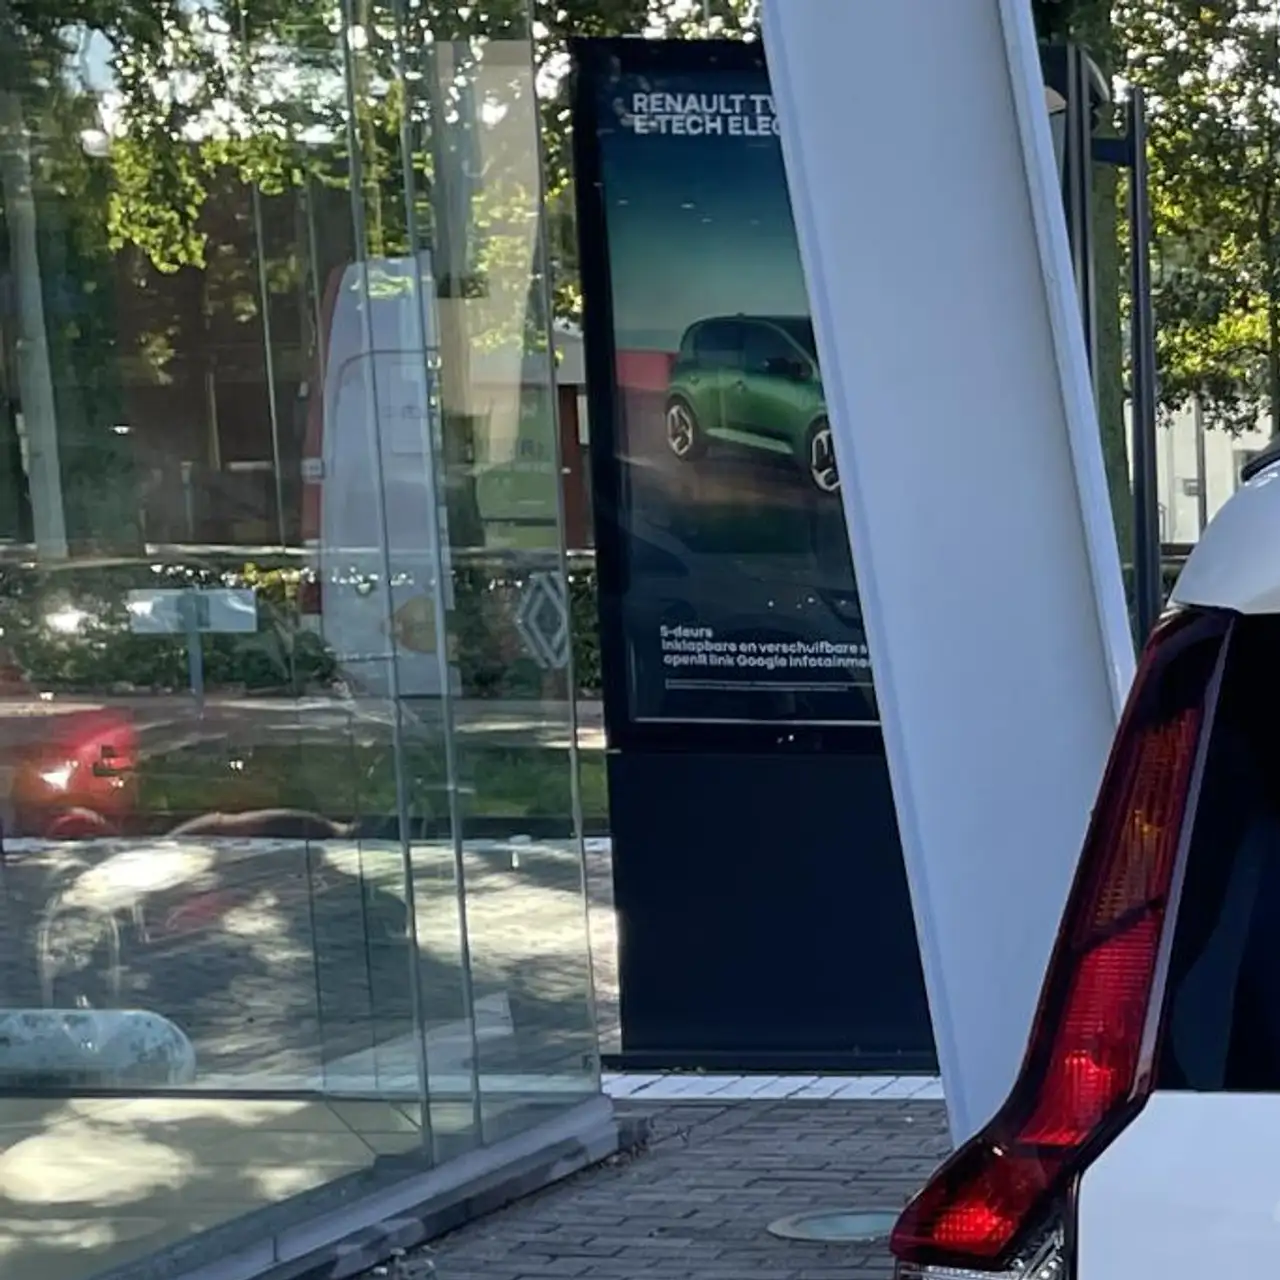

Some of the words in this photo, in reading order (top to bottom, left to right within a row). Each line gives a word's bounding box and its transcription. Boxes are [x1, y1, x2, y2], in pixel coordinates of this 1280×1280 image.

[633, 93, 745, 114] RENAULT
[633, 114, 722, 135] E-TECH
[660, 625, 714, 638] 5-deurs
[739, 642, 757, 653] en
[758, 640, 859, 655] verschuifbare
[736, 654, 788, 671] Google
